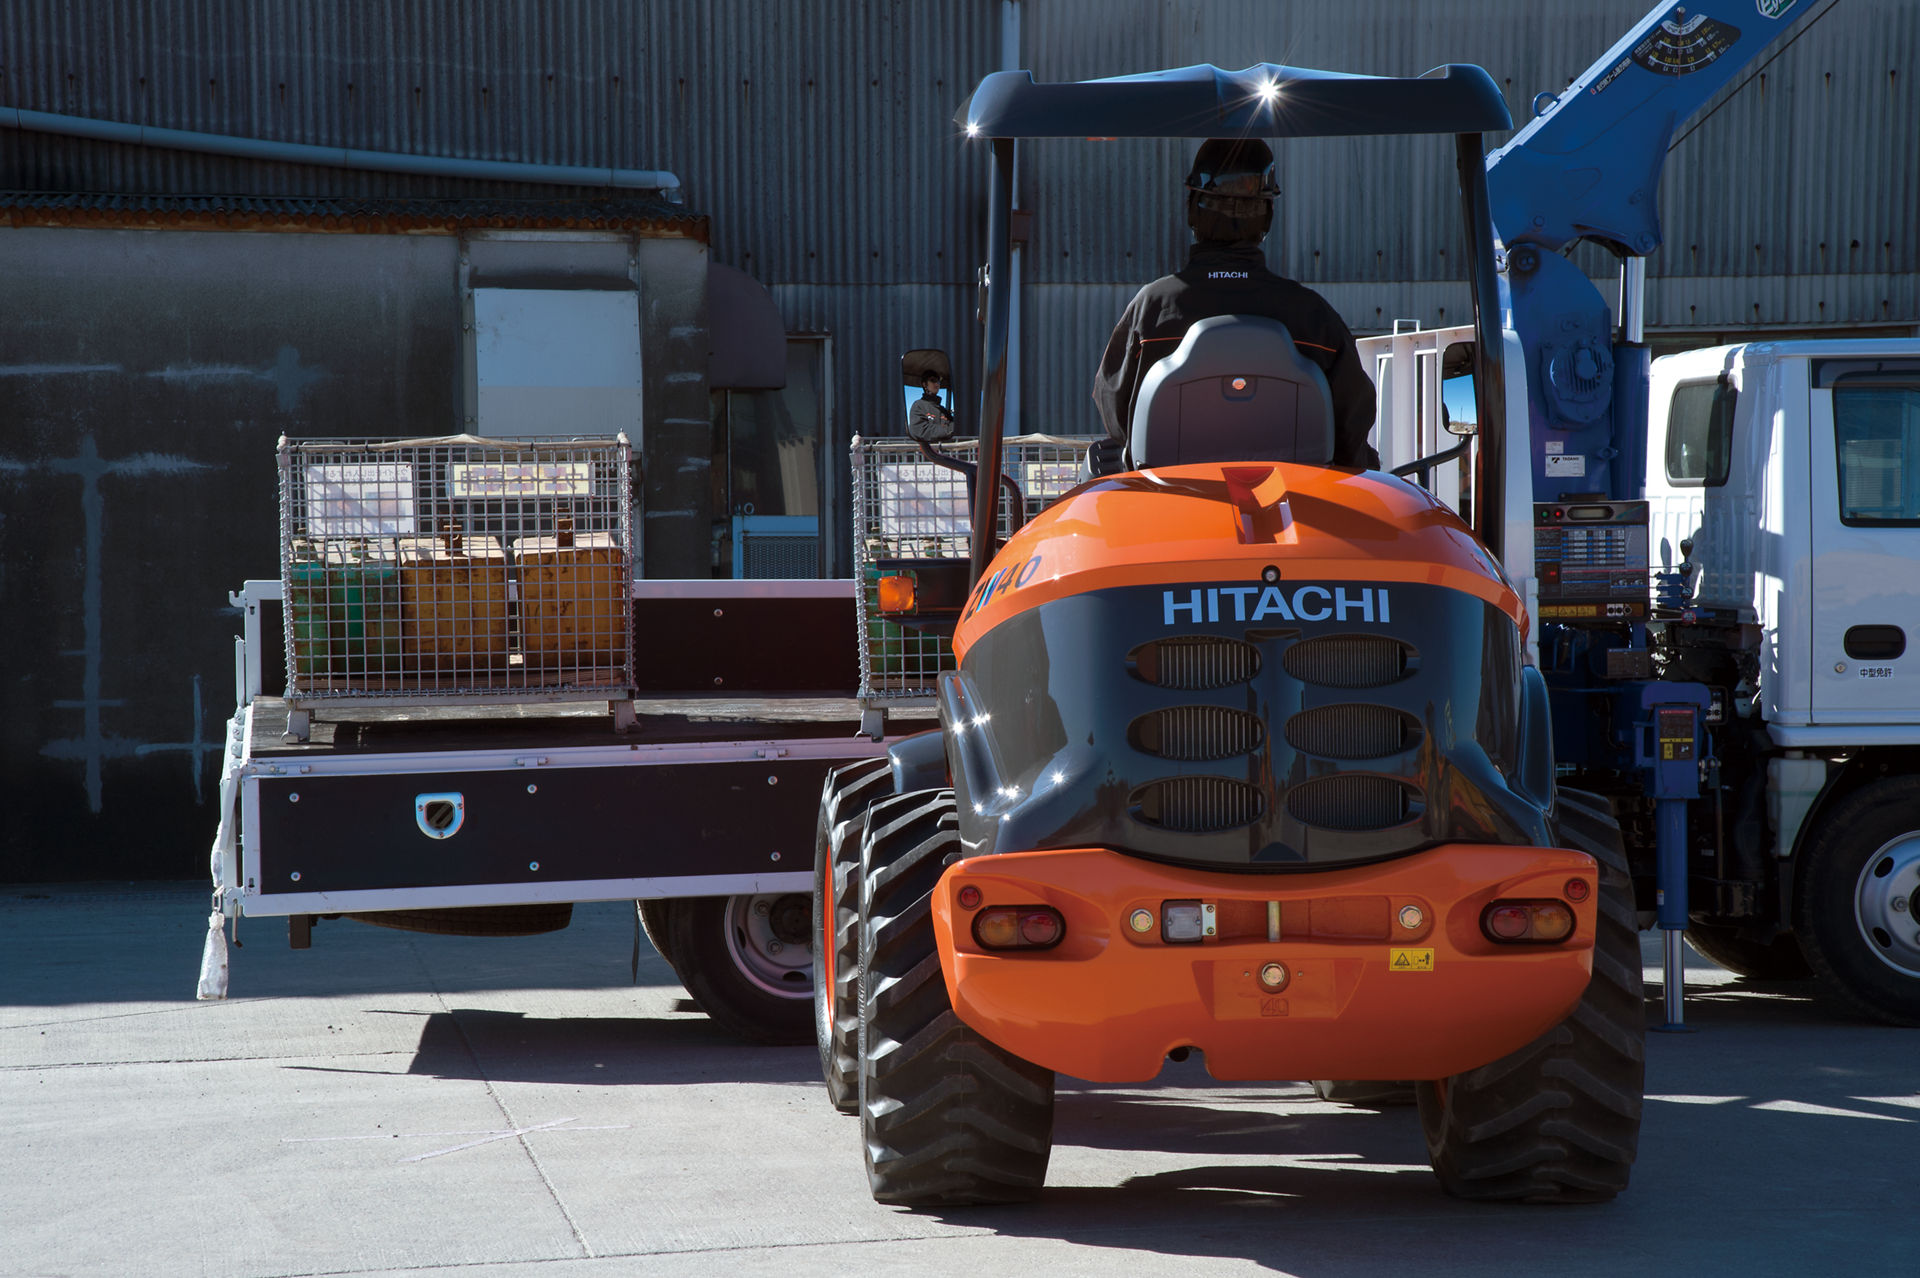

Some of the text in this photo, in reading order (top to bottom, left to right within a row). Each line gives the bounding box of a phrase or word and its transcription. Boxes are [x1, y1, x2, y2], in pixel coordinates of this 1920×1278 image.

[1208, 271, 1248, 279] HITACHI
[1163, 585, 1390, 624] HITACHI
[1859, 667, 1893, 678] 中型免許
